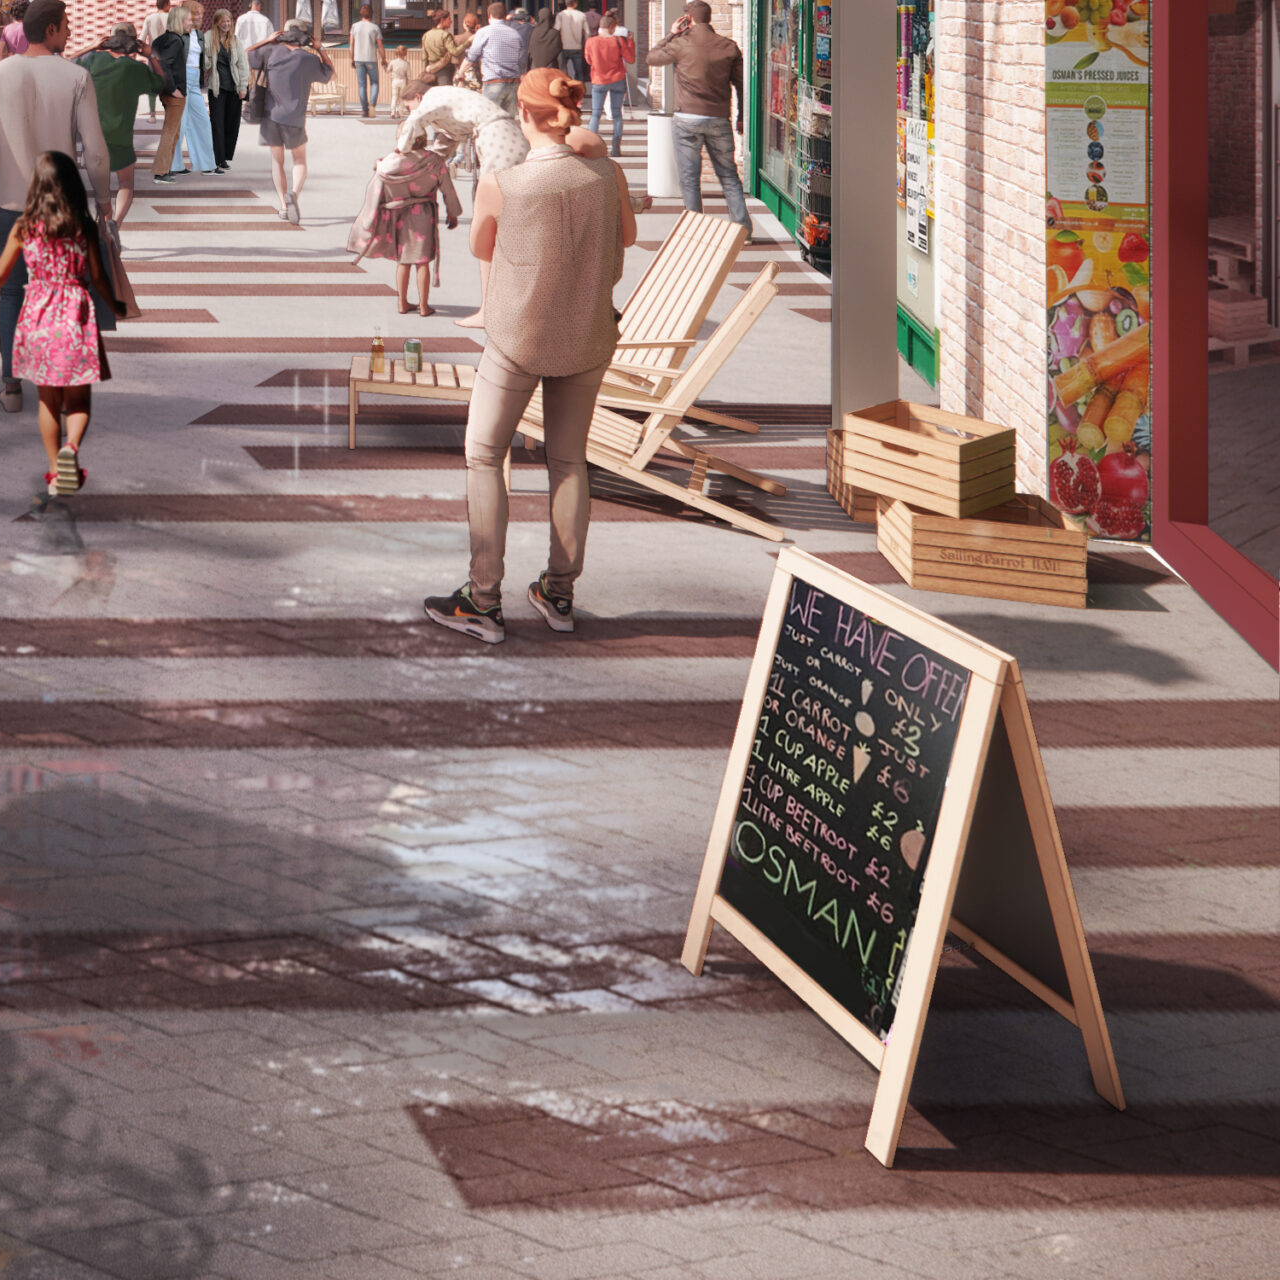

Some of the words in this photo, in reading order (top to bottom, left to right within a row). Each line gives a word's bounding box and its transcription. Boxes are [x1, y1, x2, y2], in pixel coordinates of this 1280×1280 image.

[1084, 70, 1114, 81] PRESSED
[1116, 71, 1139, 81] JUICES
[784, 623, 814, 647] JUST
[820, 647, 862, 677] CARROT
[790, 581, 824, 634] WE
[834, 605, 905, 677] HAVE
[774, 654, 800, 676] JUST
[808, 675, 852, 708] ORANGE
[806, 655, 821, 670] OR
[763, 696, 780, 716] OR
[785, 710, 846, 760] ORANGE
[792, 689, 852, 742] CARROT
[885, 688, 942, 733] ONLY
[758, 715, 769, 736] 1
[775, 730, 804, 759] CUP
[803, 754, 851, 795] APPLE
[872, 801, 899, 831] £2
[878, 738, 930, 779] JUST
[752, 739, 764, 762] 1
[768, 753, 802, 787] LITRE
[803, 783, 846, 818] APPLE
[866, 825, 893, 851] £6
[746, 764, 757, 784] 1
[759, 775, 784, 803] CUP
[786, 794, 858, 860] BEETROOT
[865, 856, 890, 889] £2
[736, 821, 877, 965] OSMAN
[786, 824, 860, 892] BEETROOT
[866, 891, 895, 925] £6
